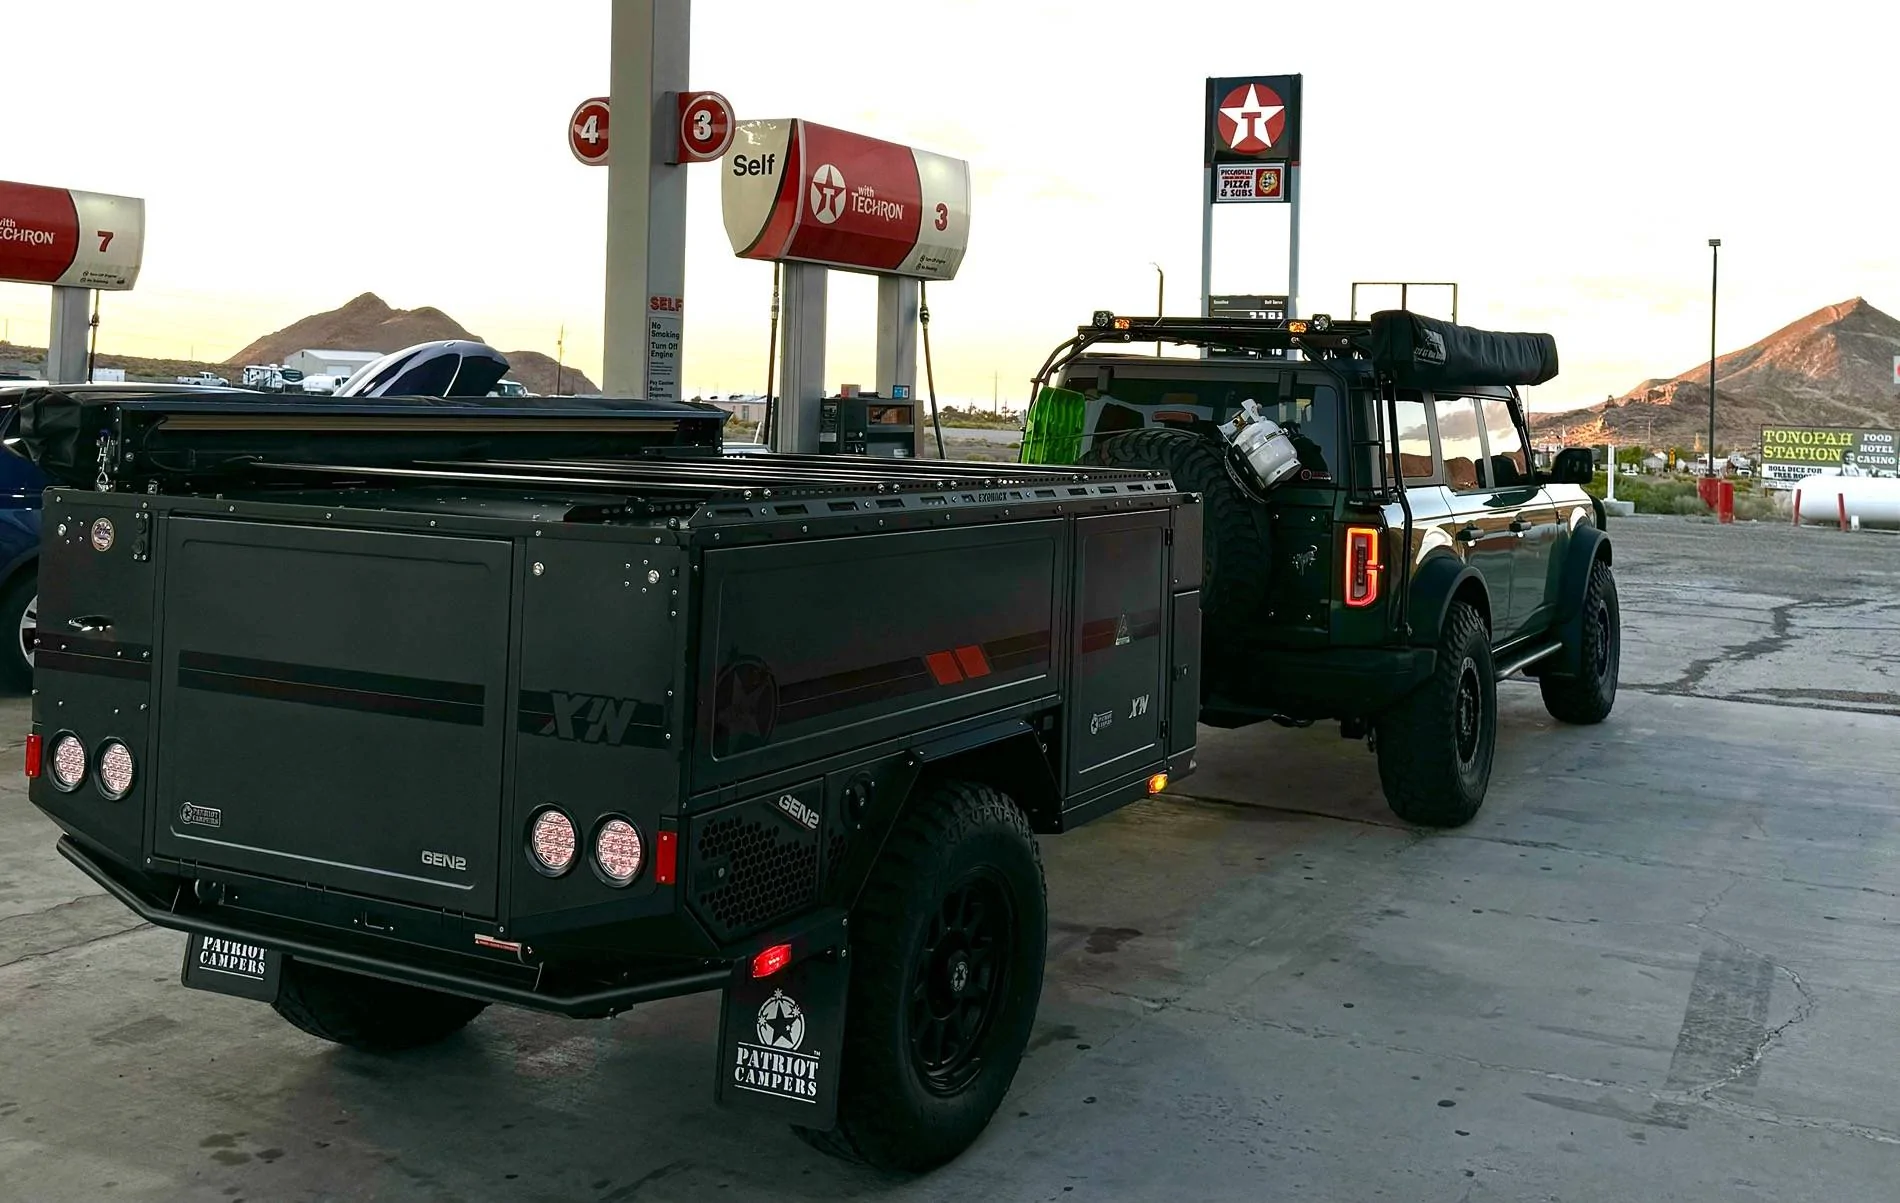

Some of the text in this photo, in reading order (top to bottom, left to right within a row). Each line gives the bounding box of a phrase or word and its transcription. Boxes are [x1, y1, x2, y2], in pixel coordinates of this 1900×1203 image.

[580, 115, 599, 144] 4
[693, 110, 711, 140] 3
[733, 153, 775, 176] Self
[857, 185, 874, 198] with
[1223, 180, 1250, 189] PIZZA
[1220, 189, 1253, 197] & SUBS
[851, 191, 904, 221] TECHRON
[934, 202, 949, 232] 3
[97, 230, 114, 253] 7
[650, 296, 683, 312] SELF
[651, 321, 661, 329] No
[651, 330, 680, 340] Smoking
[651, 341, 678, 350] Turn Off
[650, 350, 674, 359] Engine
[1763, 430, 1853, 446] TONOPAH
[1863, 433, 1892, 442] FOOD
[1763, 445, 1842, 461] STATION
[1860, 444, 1894, 453] HOTEL
[1857, 455, 1896, 465] CASINO
[779, 794, 820, 829] GEN2
[421, 850, 467, 871] GEN2
[202, 936, 268, 961] PATRIOT
[200, 951, 266, 975] CAMPERS
[736, 1047, 819, 1080] PATRIOT
[734, 1066, 817, 1096] CAMPERS
